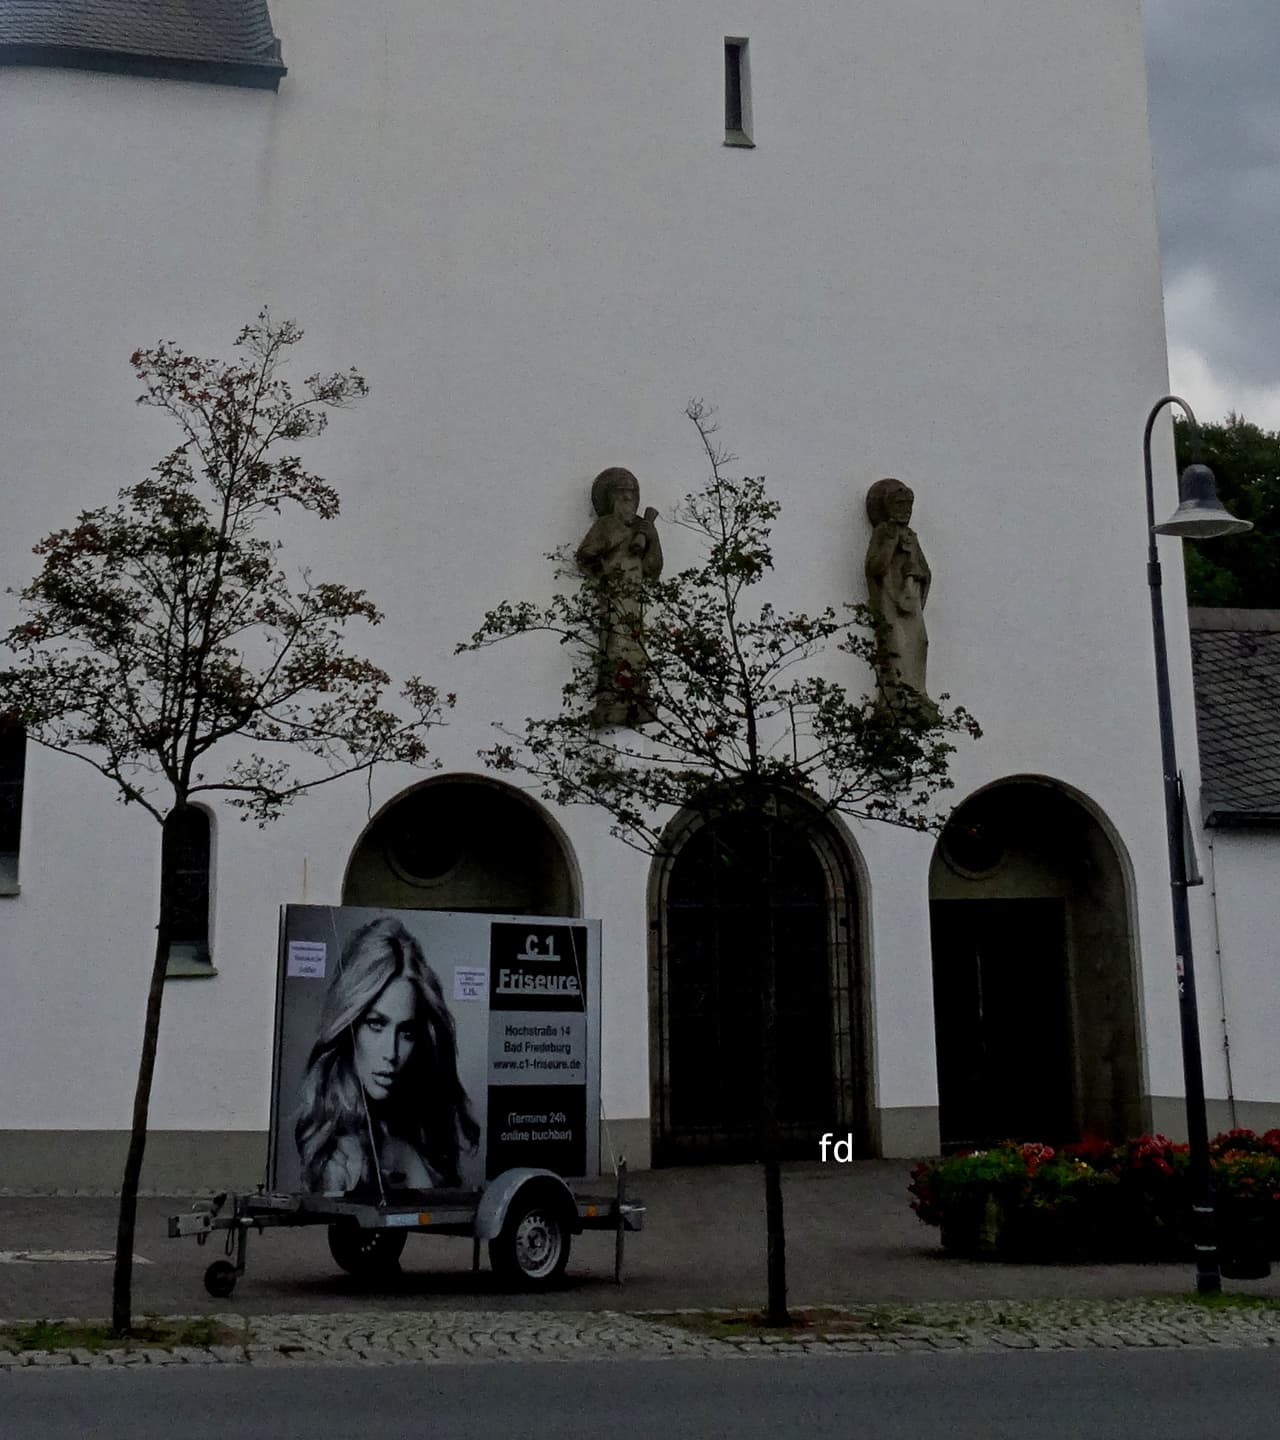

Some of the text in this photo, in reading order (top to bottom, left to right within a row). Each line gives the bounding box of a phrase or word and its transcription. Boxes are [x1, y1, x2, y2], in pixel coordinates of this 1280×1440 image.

[499, 968, 579, 991] Friseure
[505, 1025, 570, 1037] Hochstraße 14
[504, 1041, 523, 1053] Bad
[500, 1129, 530, 1142] online
